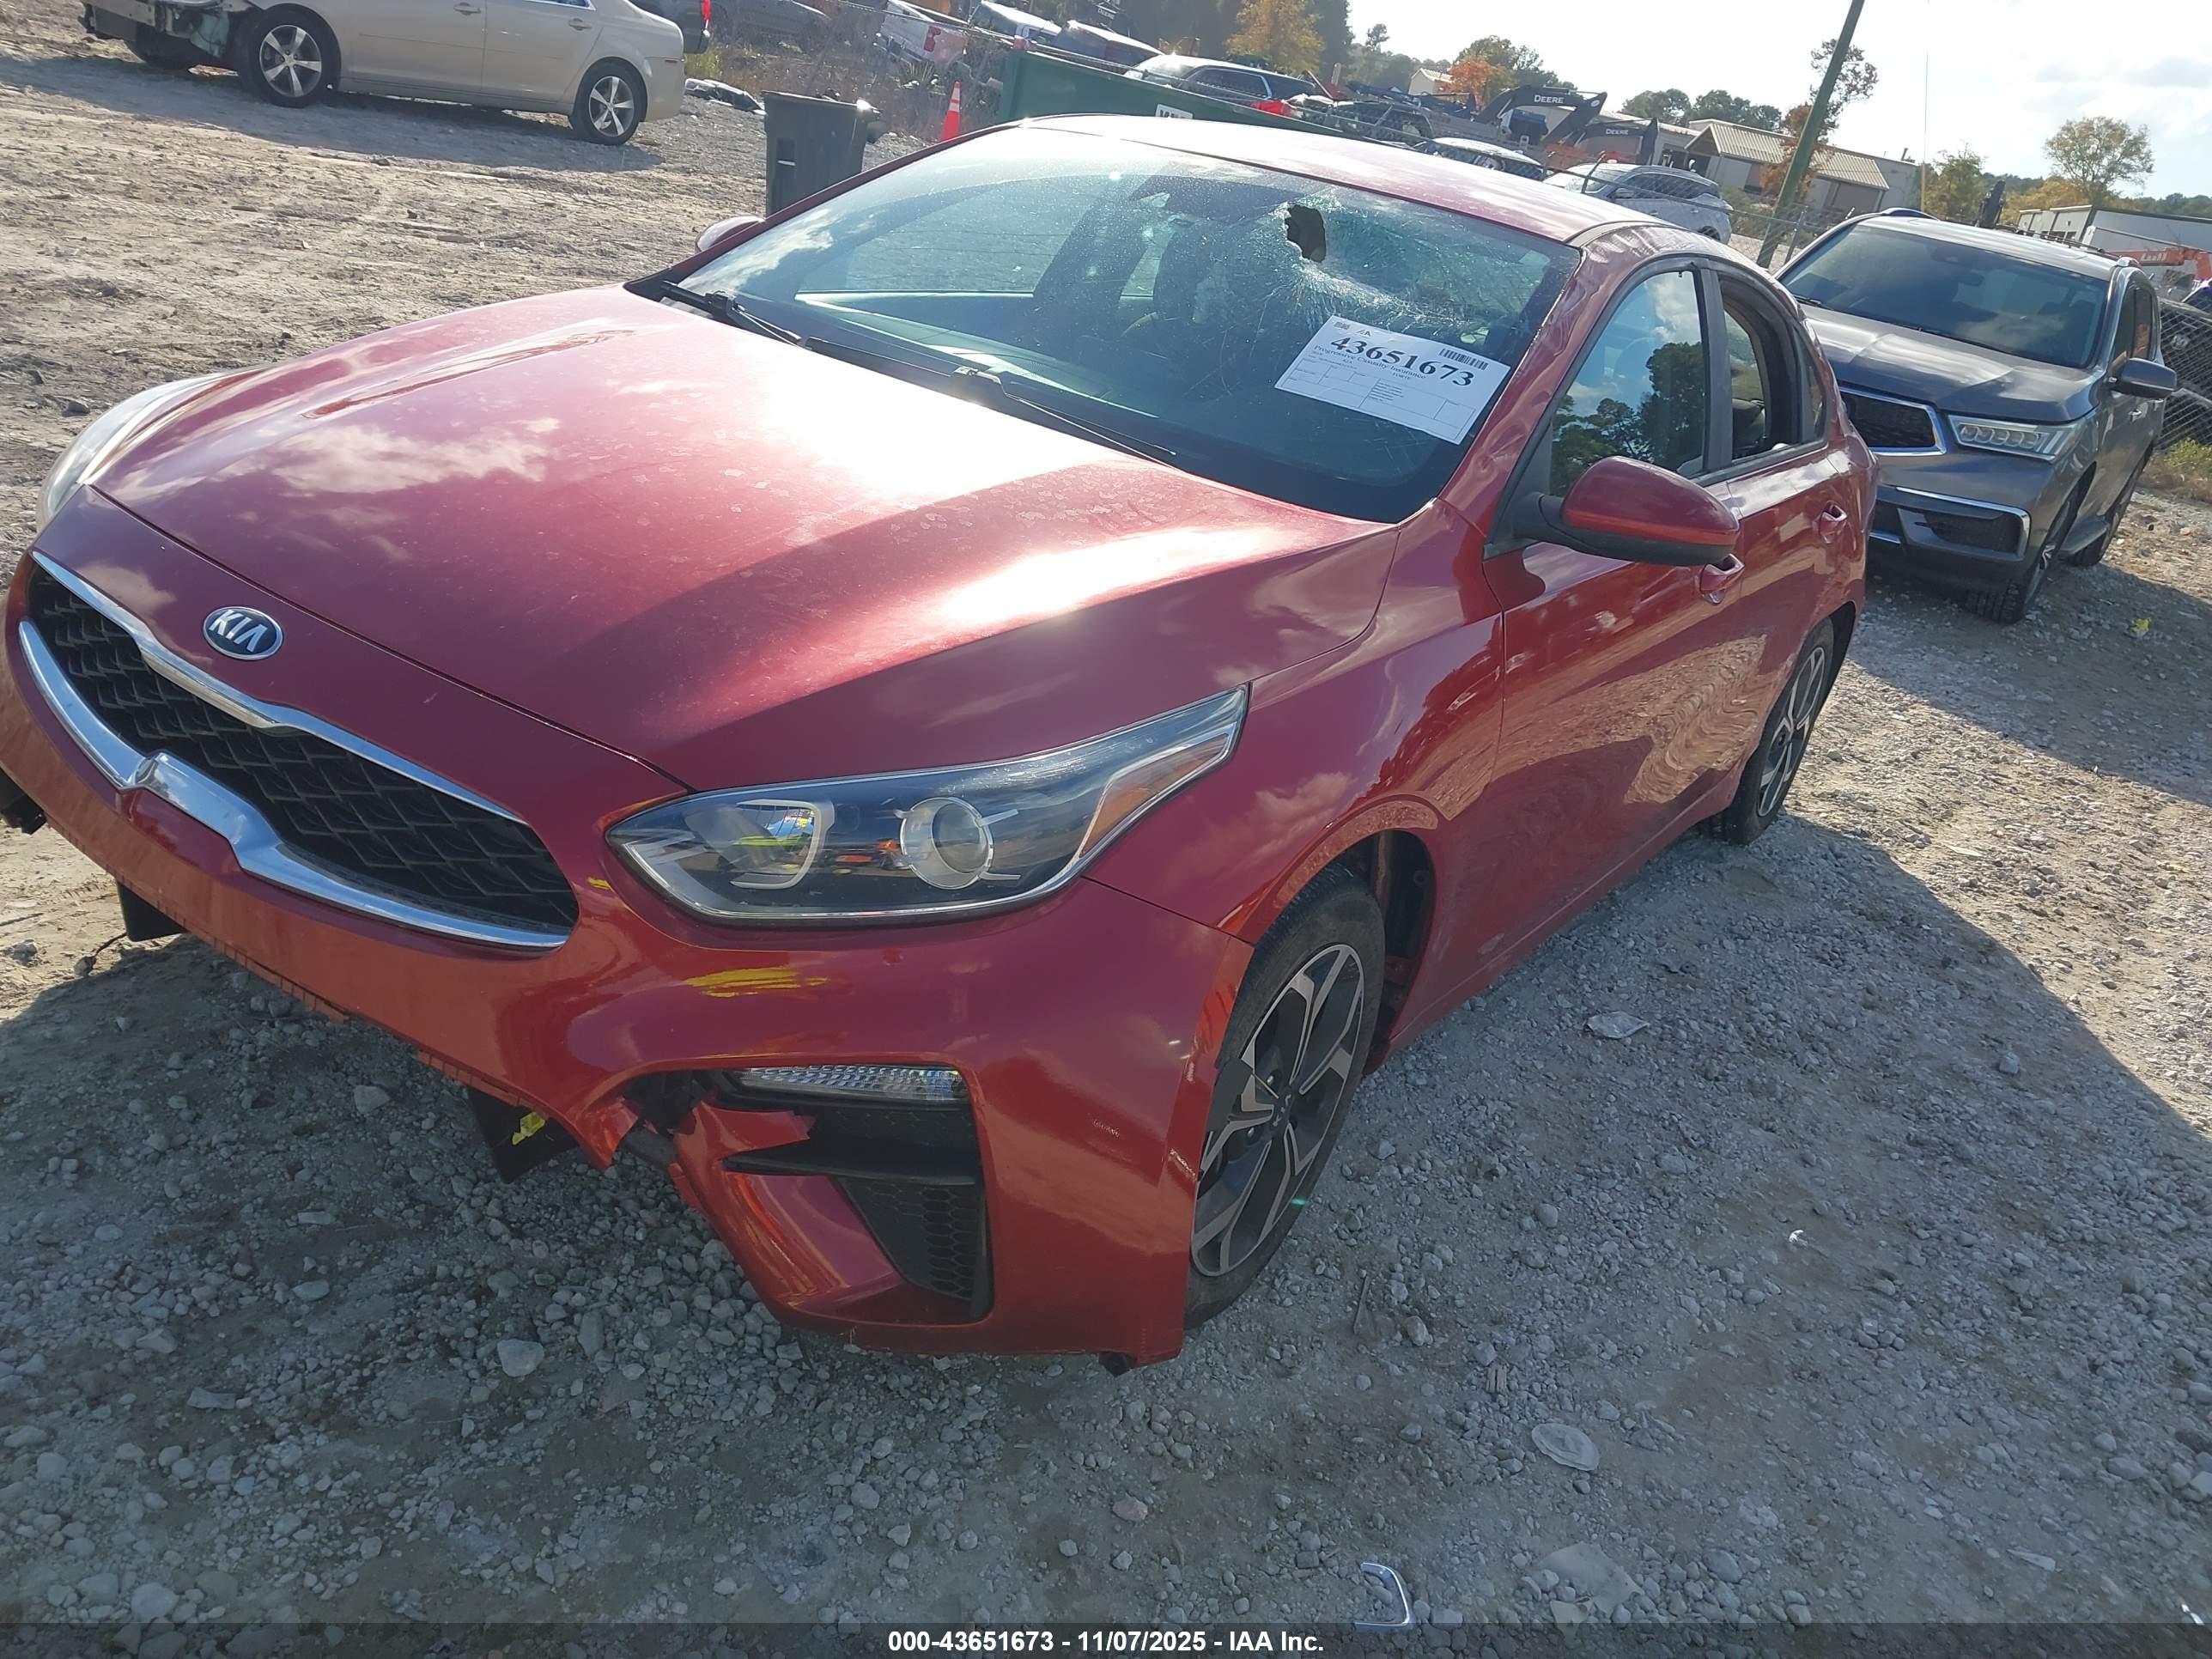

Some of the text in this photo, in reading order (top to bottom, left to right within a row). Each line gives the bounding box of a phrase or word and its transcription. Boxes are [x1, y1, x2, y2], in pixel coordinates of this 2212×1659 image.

[1534, 94, 1564, 103] DEERE
[1314, 345, 1356, 361] Progressive
[1357, 356, 1389, 369] Casualty
[1390, 365, 1427, 379] Insurance
[1330, 337, 1475, 387] 43651673
[208, 609, 268, 653] KIA
